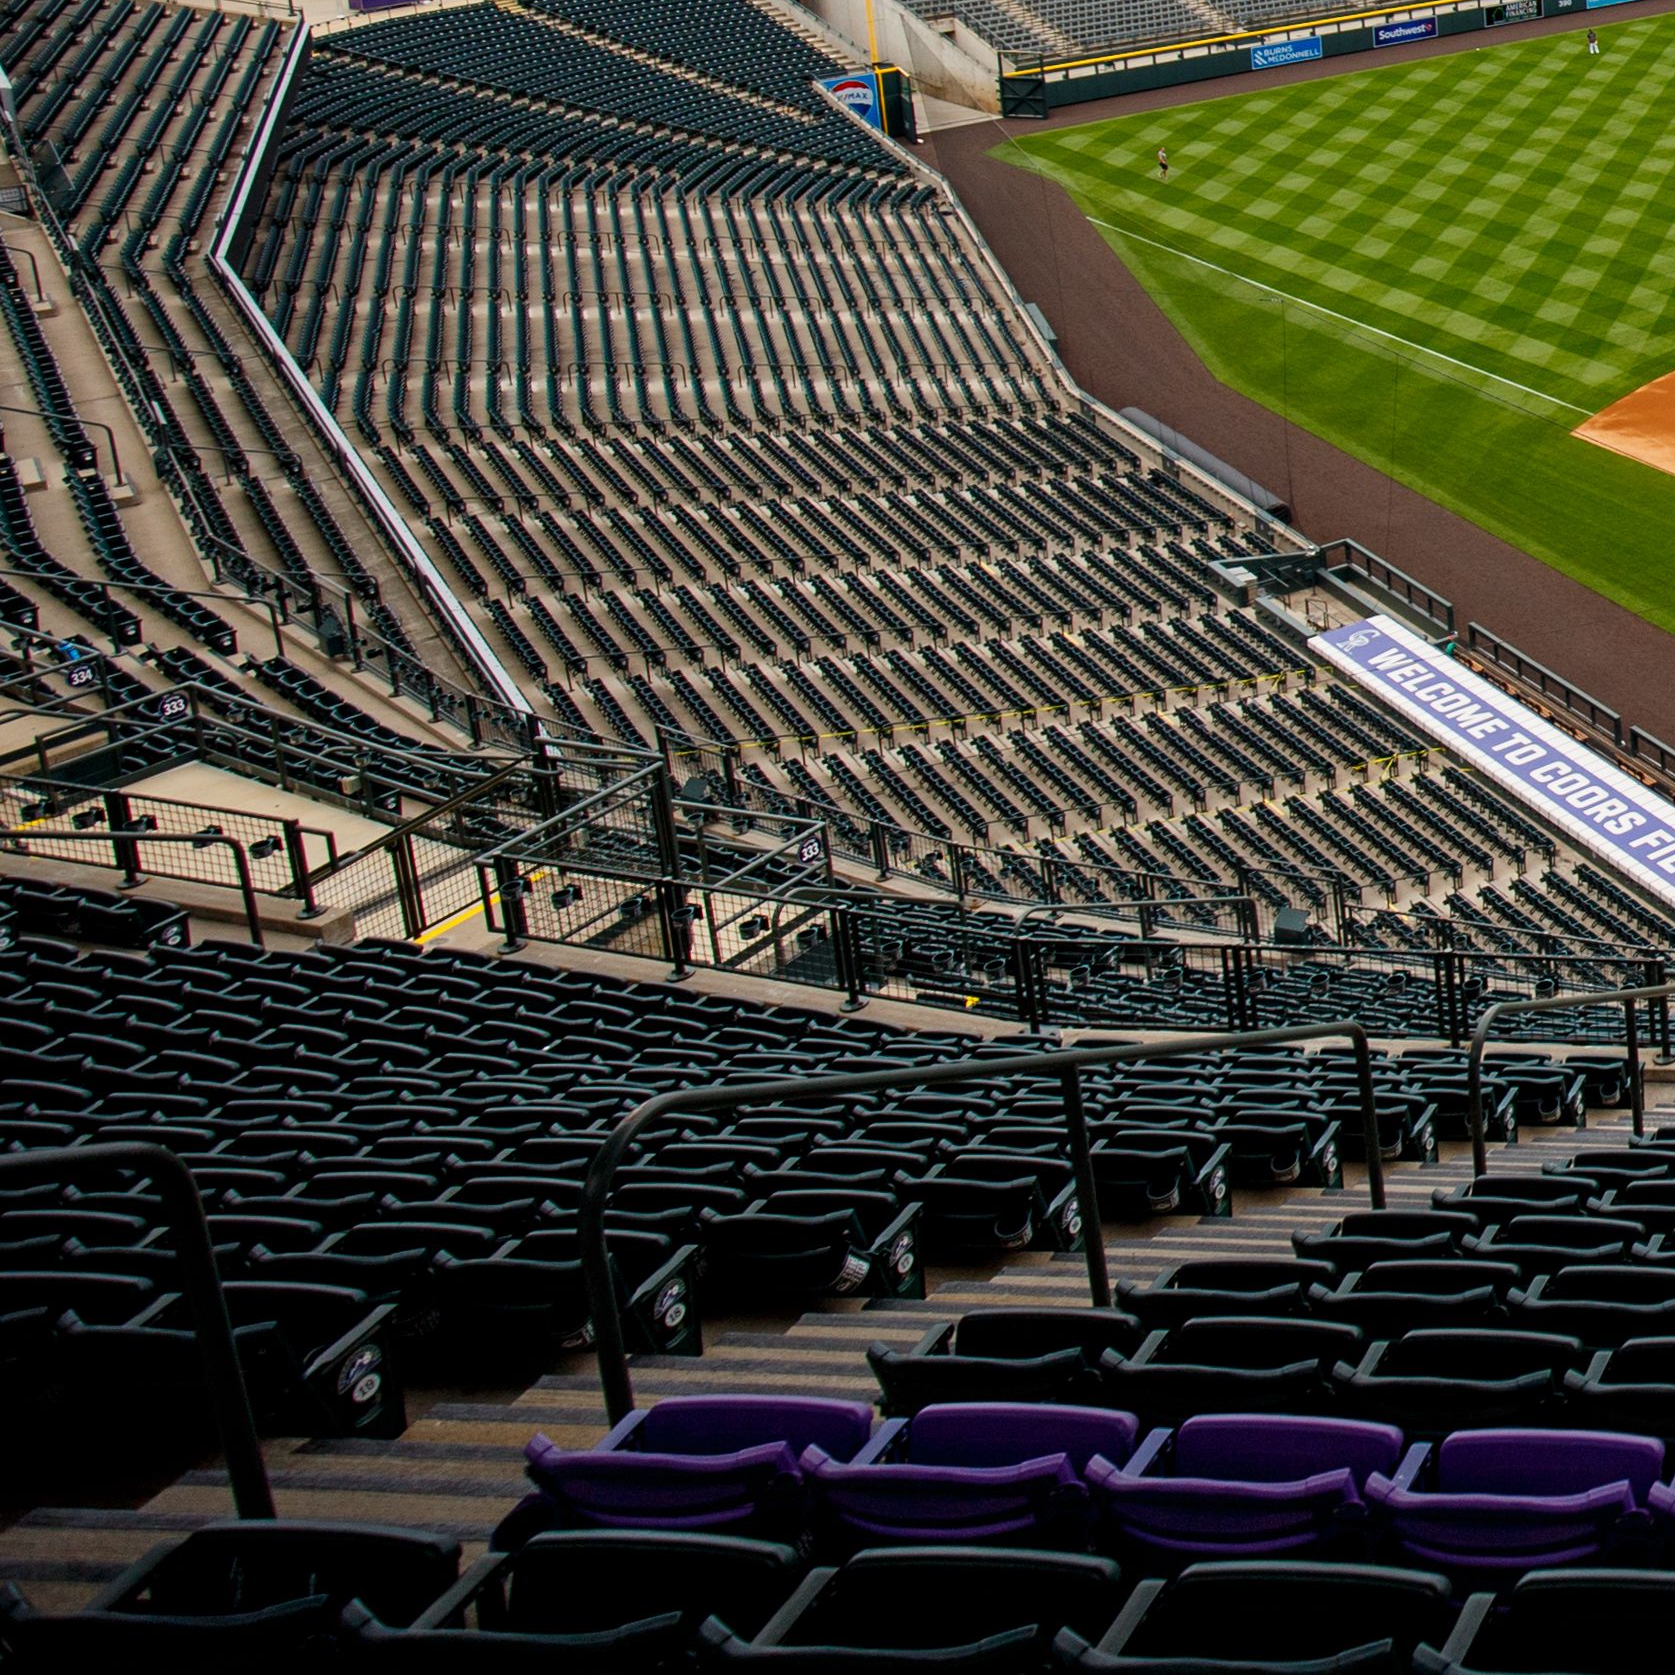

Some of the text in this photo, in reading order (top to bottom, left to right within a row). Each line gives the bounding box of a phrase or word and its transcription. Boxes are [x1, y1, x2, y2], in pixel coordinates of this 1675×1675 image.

[1378, 23, 1427, 41] Southwest
[1263, 45, 1294, 57] BURNS
[70, 667, 92, 685] 334
[163, 699, 187, 716] 333
[1367, 646, 1511, 741] WELCOME
[1490, 732, 1543, 766] TO
[1529, 760, 1646, 836] COORS
[359, 1379, 375, 1396] 19
